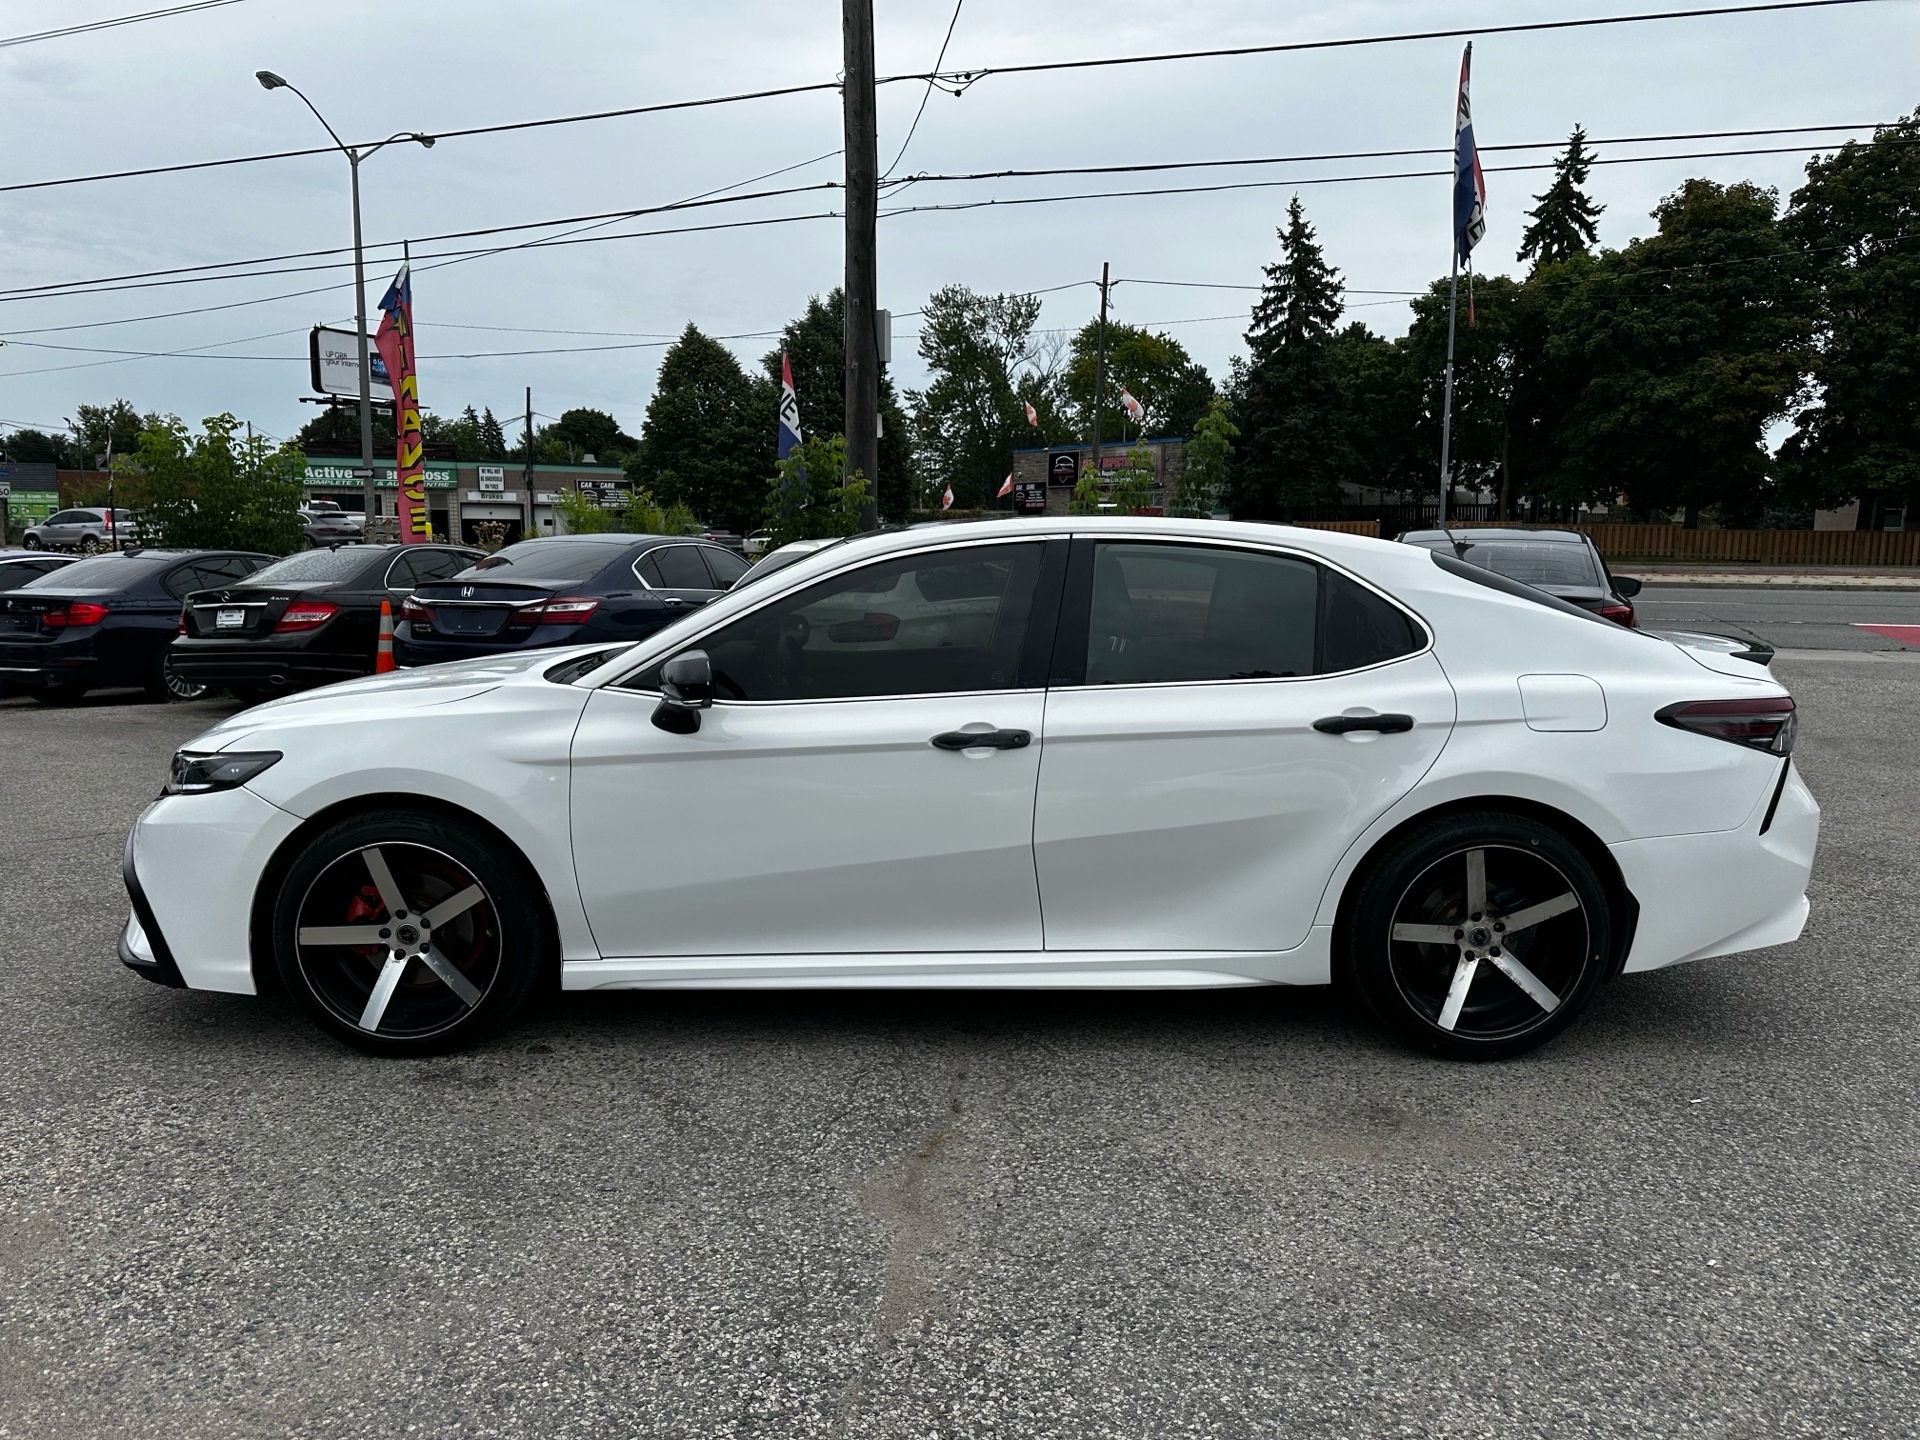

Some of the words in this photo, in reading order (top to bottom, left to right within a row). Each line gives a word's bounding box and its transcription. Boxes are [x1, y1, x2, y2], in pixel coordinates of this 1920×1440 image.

[341, 359, 360, 367] Intern
[305, 466, 353, 479] Active
[423, 470, 450, 481] oss
[481, 492, 504, 500] Brakes
